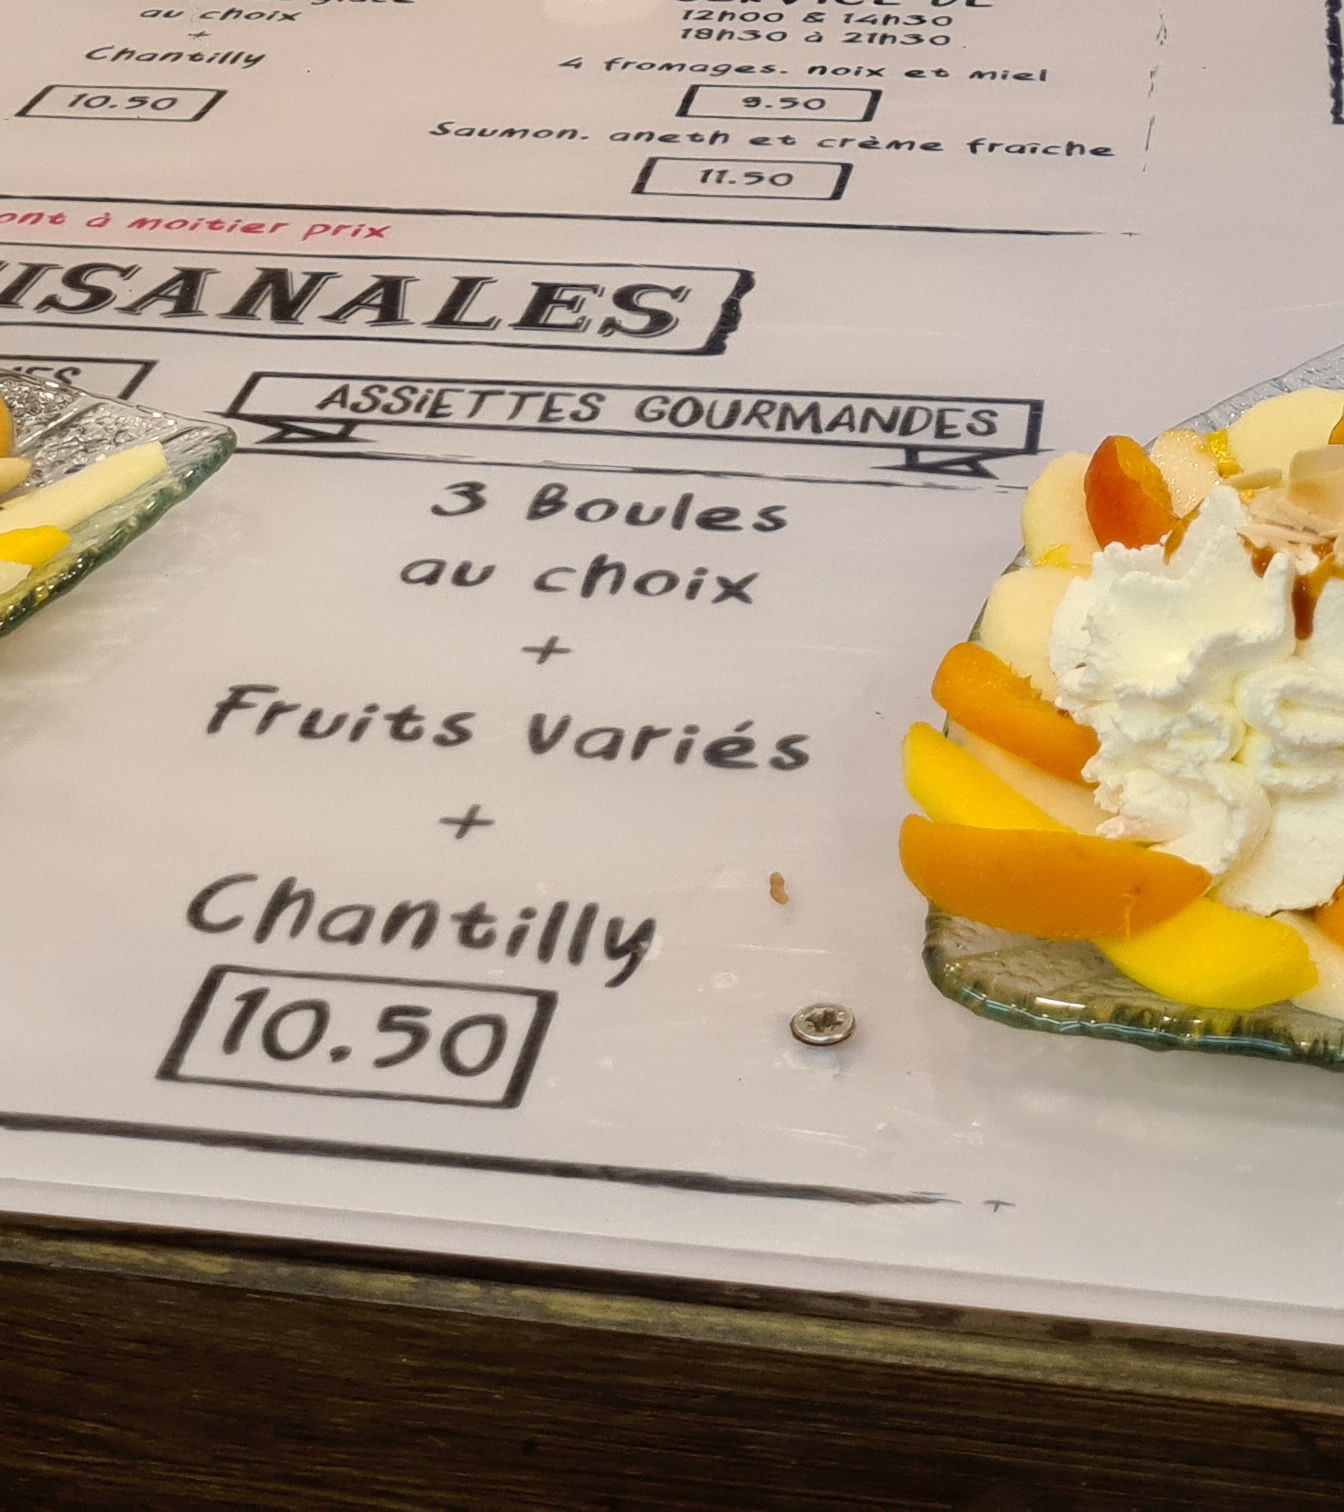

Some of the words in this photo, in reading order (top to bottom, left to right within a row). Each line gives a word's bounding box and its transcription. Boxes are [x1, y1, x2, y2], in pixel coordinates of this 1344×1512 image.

[139, 9, 185, 19] au
[199, 7, 302, 22] choix
[682, 9, 785, 23] 12h00
[843, 12, 953, 27] 14h30
[681, 27, 788, 42] 18h30
[841, 31, 951, 46] 21h30
[85, 45, 266, 69] Chantilly
[558, 56, 583, 70] 4
[807, 65, 886, 78] noix
[903, 67, 950, 79] et
[968, 68, 1048, 82] miel
[68, 92, 179, 111] 10.50
[742, 96, 826, 111] 9.50
[609, 129, 730, 146] aneth
[748, 134, 797, 146] et
[817, 135, 944, 152] crème
[699, 168, 794, 187] 11.50
[86, 213, 111, 229] à
[128, 216, 289, 235] moitier
[303, 221, 392, 241] prix
[634, 395, 999, 440] GOURMANDES
[430, 481, 487, 517] 3
[525, 482, 787, 533] Boules
[400, 558, 496, 588] au
[533, 553, 759, 605] choix
[206, 683, 476, 748] Fruits
[186, 873, 656, 988] Chantilly
[222, 987, 508, 1078] 10.50
